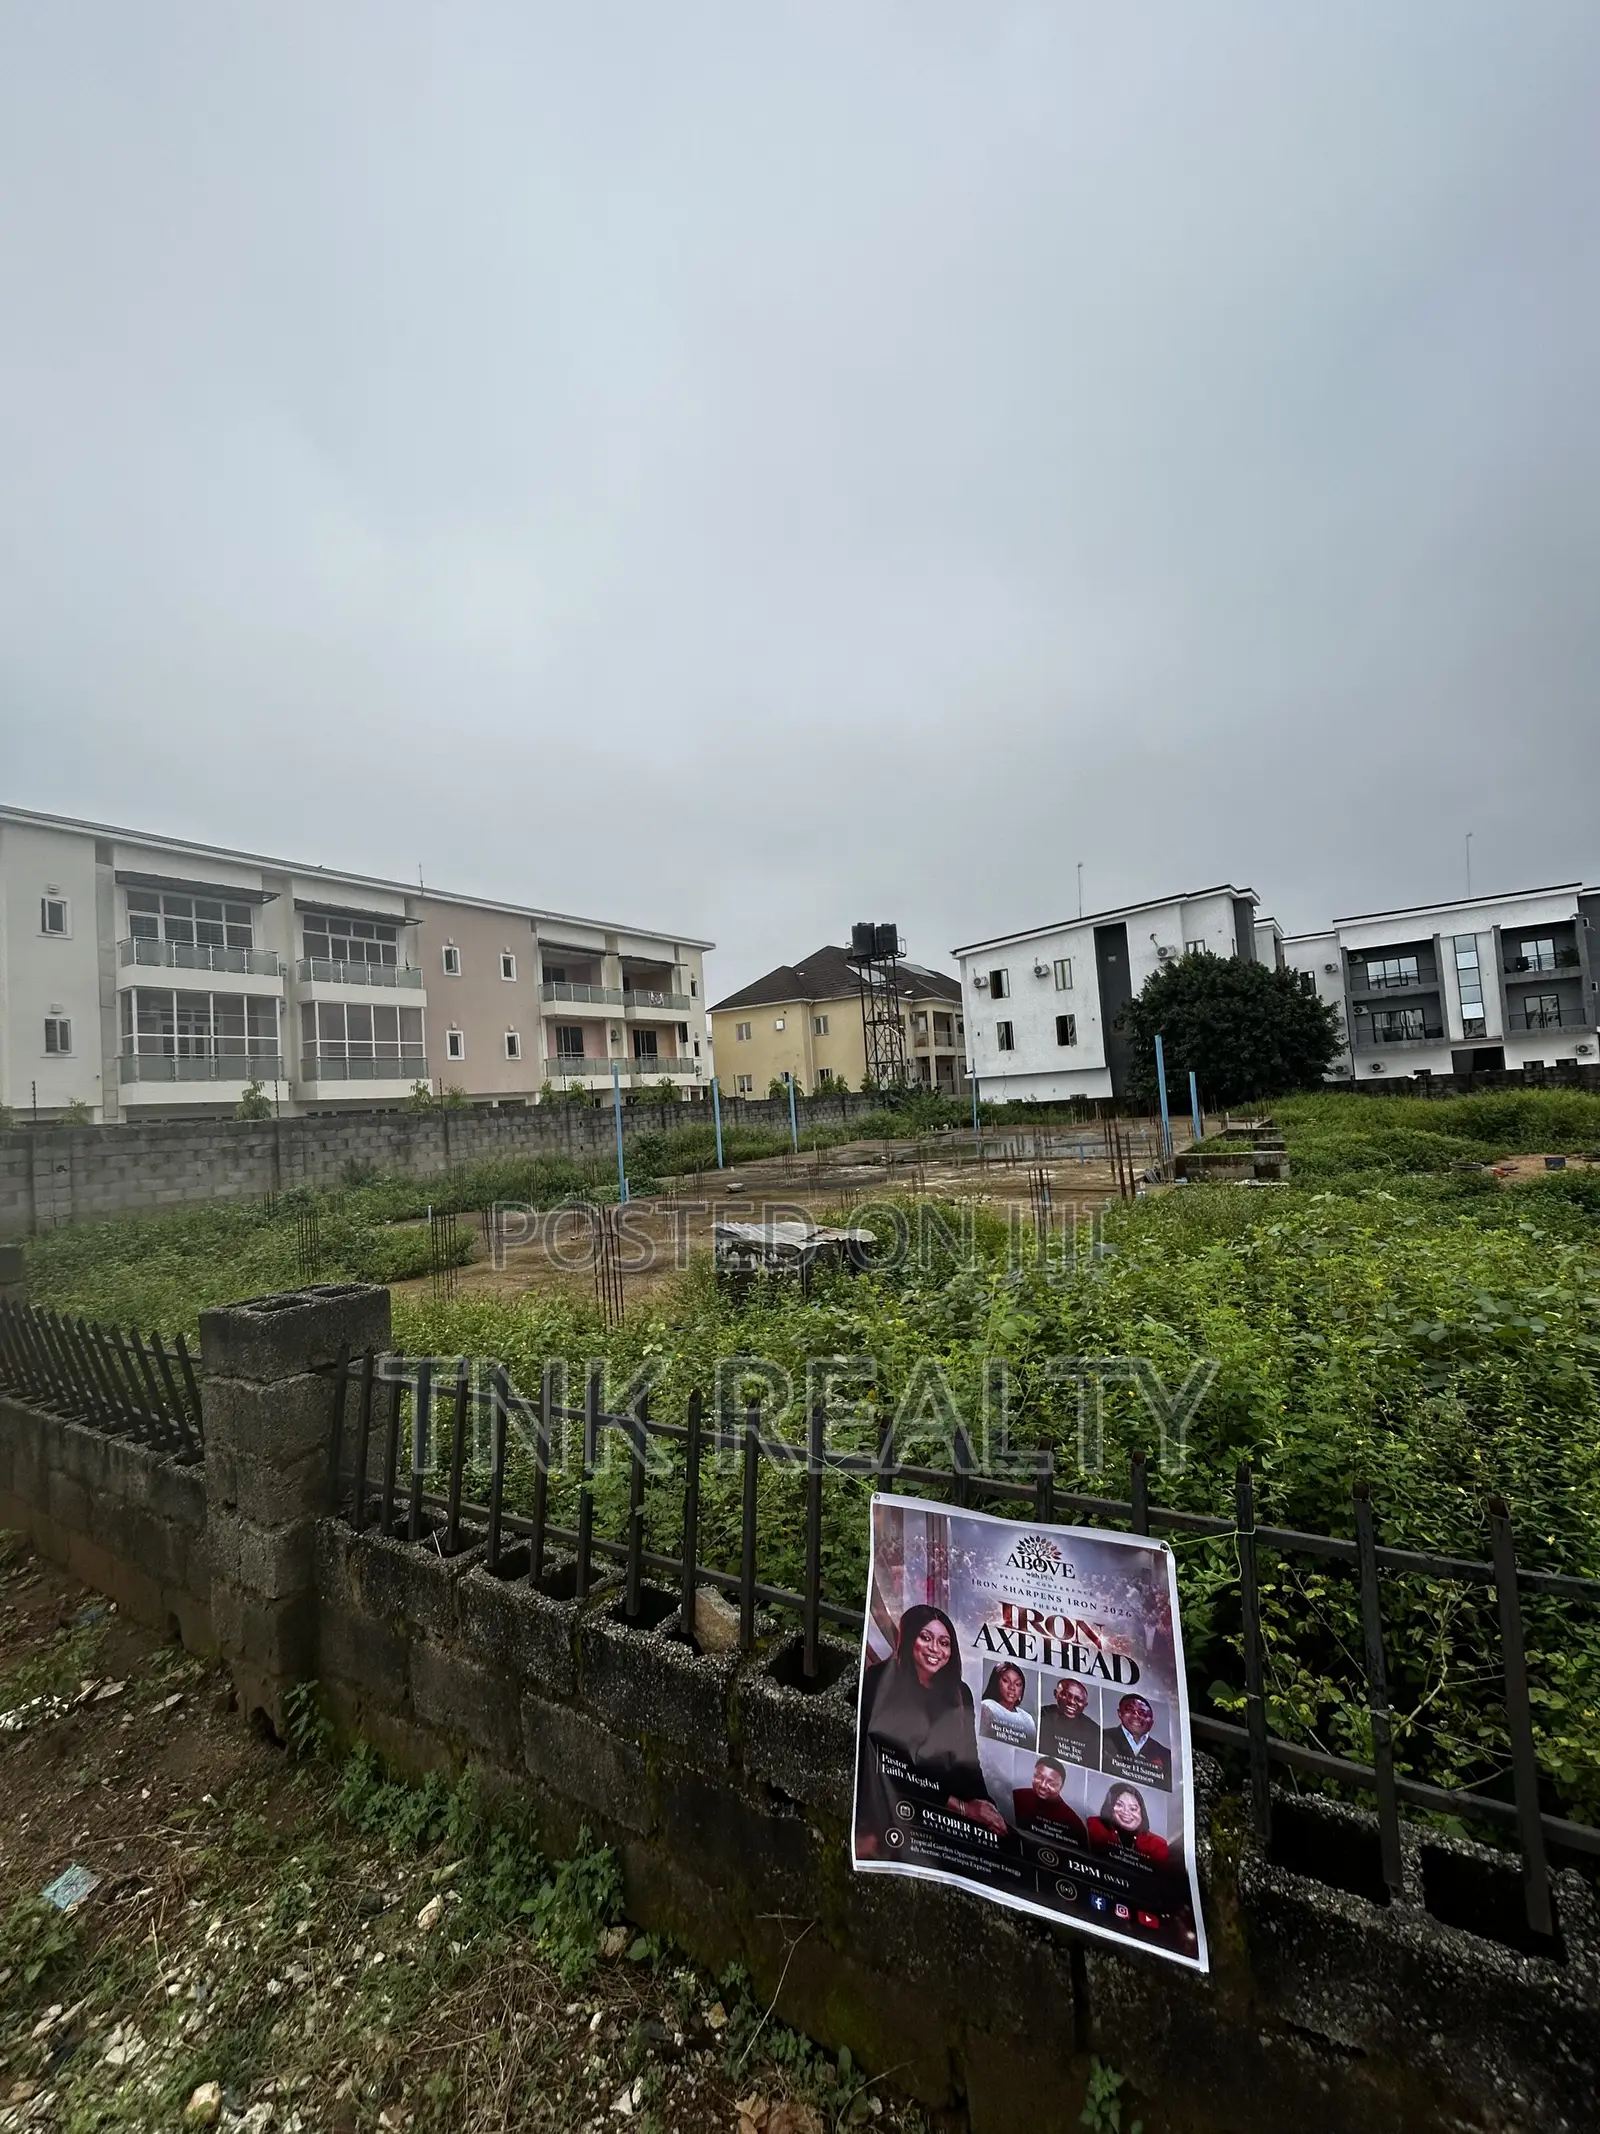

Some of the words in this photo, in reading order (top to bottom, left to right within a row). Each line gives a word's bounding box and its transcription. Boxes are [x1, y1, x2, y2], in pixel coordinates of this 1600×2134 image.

[1005, 1552, 1076, 1580] ABOVE
[1026, 1571, 1040, 1580] with
[971, 1578, 998, 1590] IRON
[1002, 1585, 1062, 1603] SHARPENS
[1067, 1598, 1098, 1611] IRON
[1102, 1605, 1133, 1618] 2026
[999, 1574, 1031, 1585] PRAYER
[1036, 1581, 1094, 1597] CONFERENCE
[997, 1600, 1106, 1650] IRON
[972, 1622, 1037, 1663] AXE
[1041, 1637, 1141, 1686] HEAD
[881, 1753, 909, 1770] Pastor
[881, 1763, 904, 1779] Faith
[905, 1772, 940, 1791] Afegbai
[922, 1808, 971, 1833] OCTOBER
[909, 1837, 932, 1849] Tropical
[1068, 1859, 1101, 1879] 12PM
